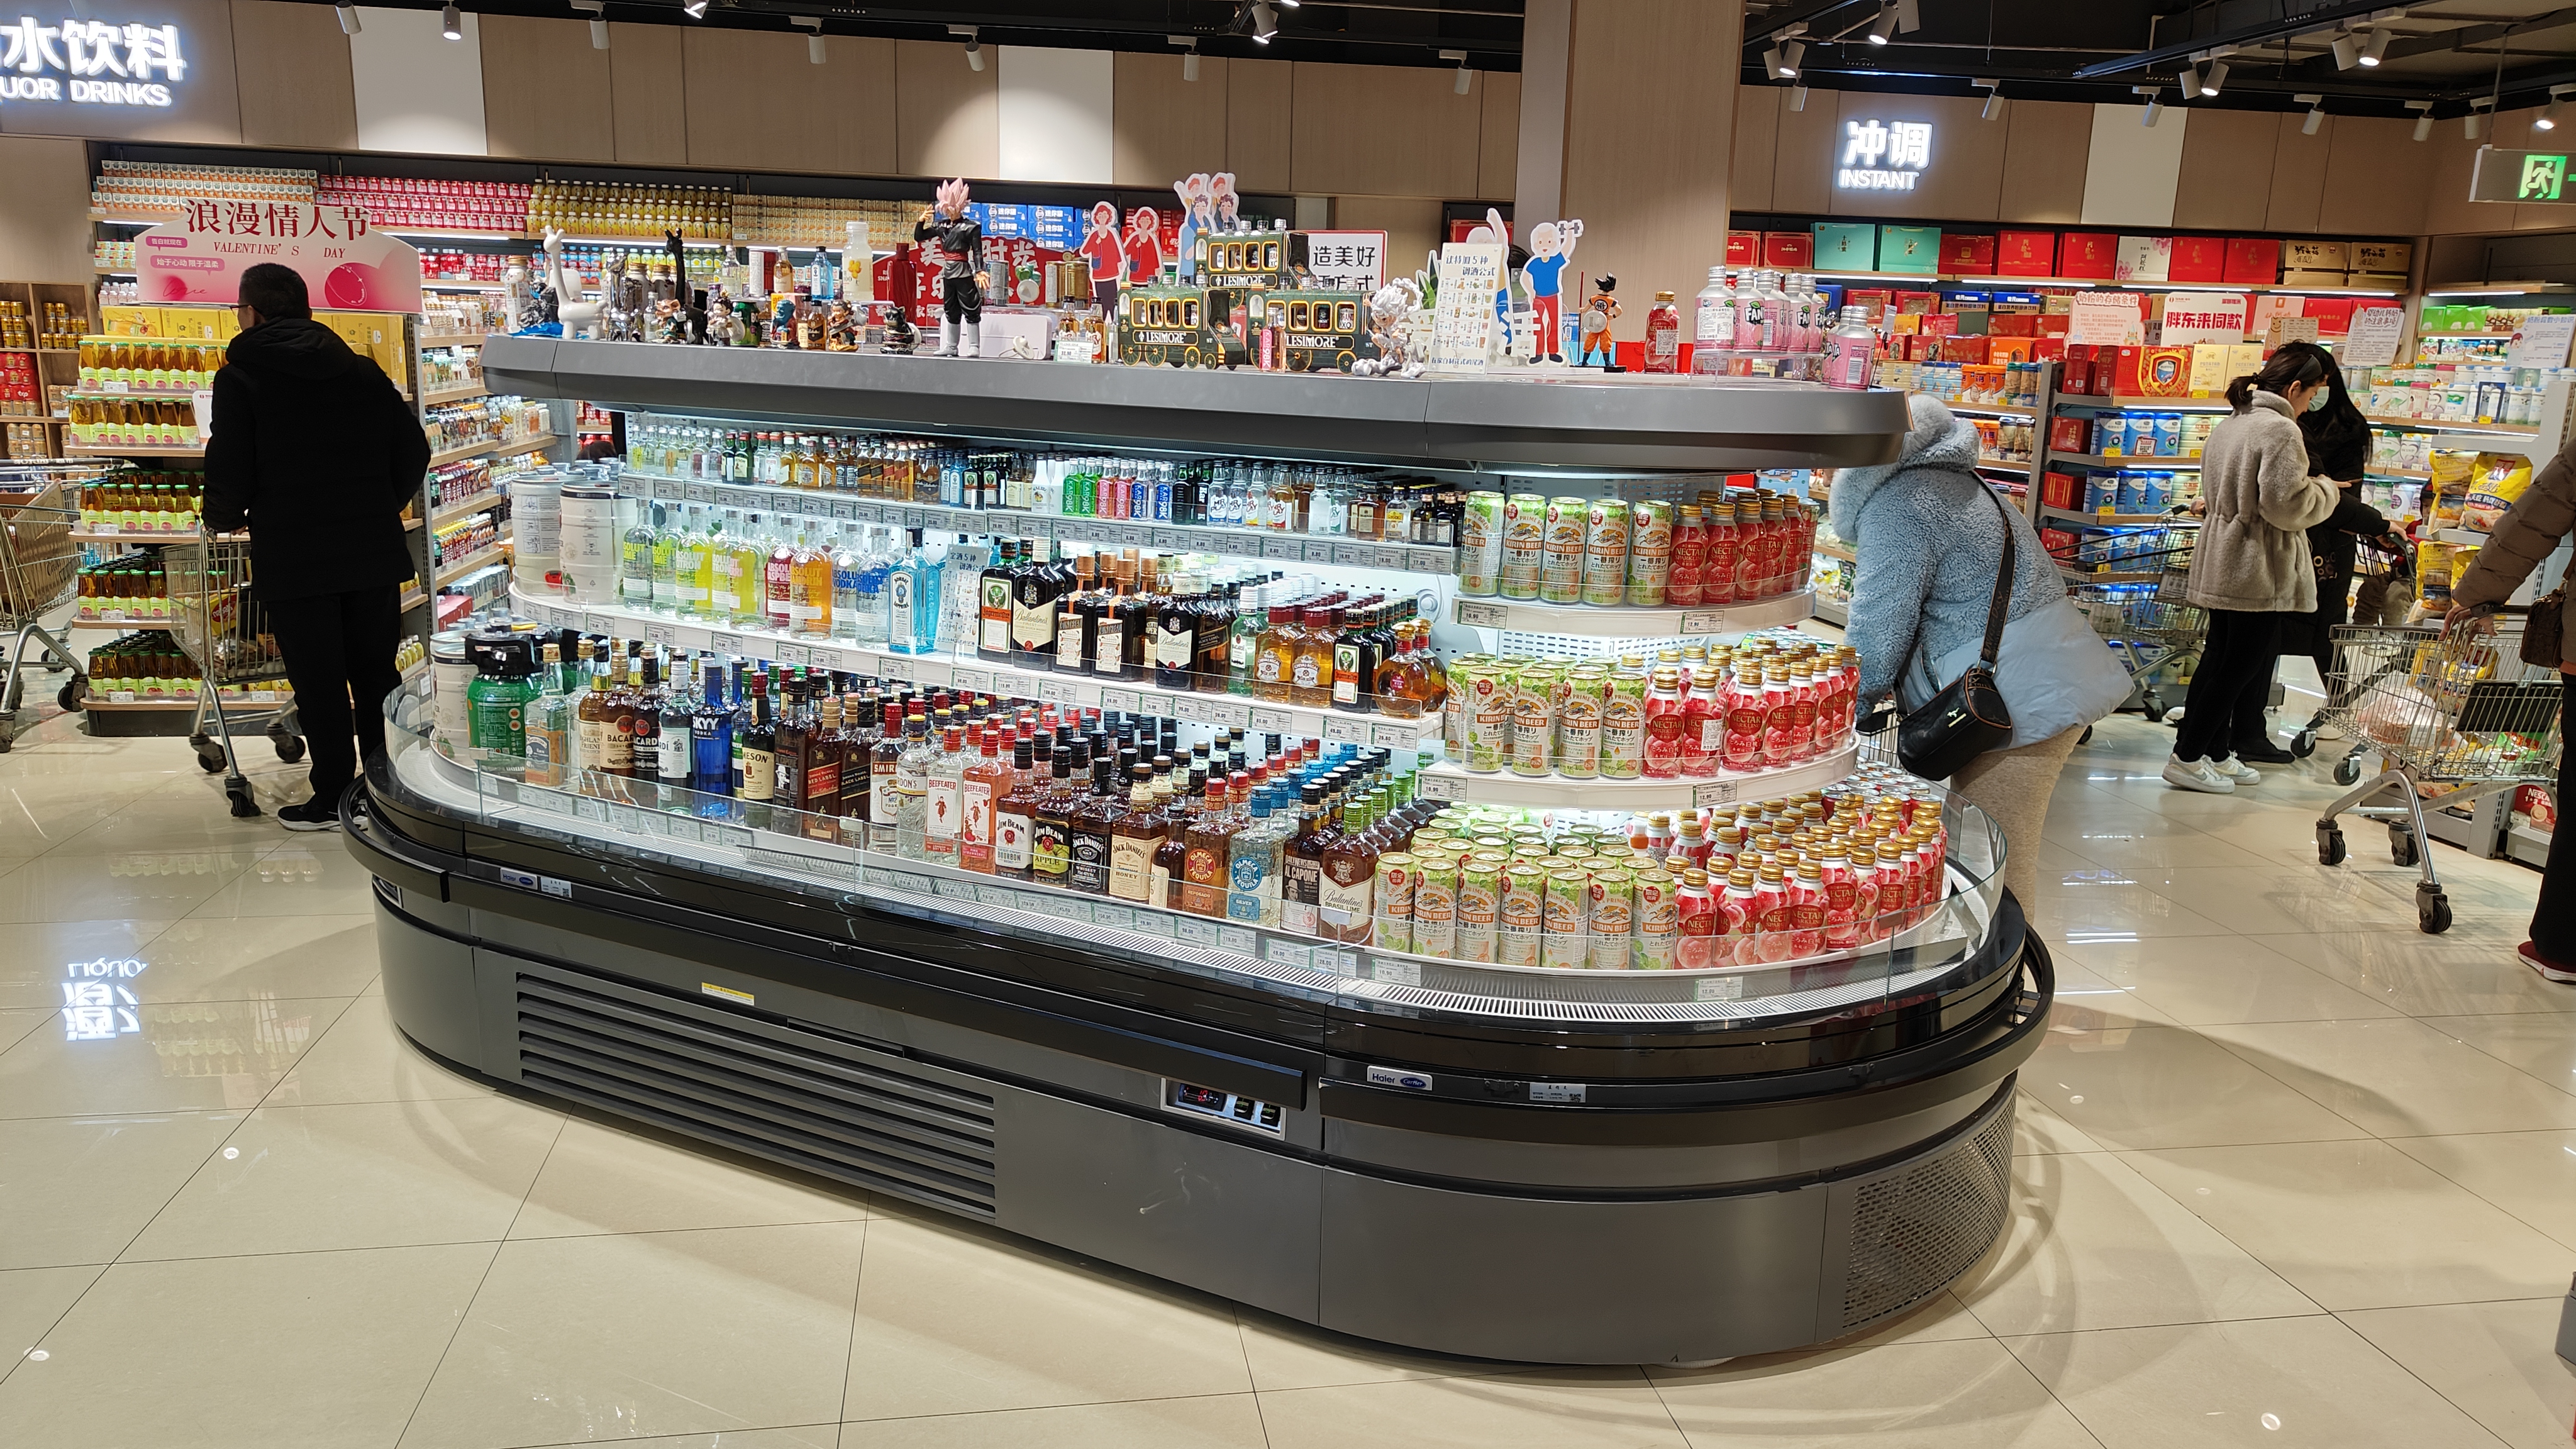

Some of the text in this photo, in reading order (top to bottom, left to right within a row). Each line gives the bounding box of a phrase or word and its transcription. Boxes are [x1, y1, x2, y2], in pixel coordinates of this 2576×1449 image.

[0, 16, 187, 80] 水饮料
[69, 79, 172, 106] DRINKS
[1842, 118, 1934, 169] 冲调
[1838, 168, 1920, 191] INSTANT
[997, 208, 1017, 216] 迷你罐
[1045, 209, 1064, 218] 迷你罐
[186, 199, 370, 241] 浪漫情人节
[1045, 225, 1063, 233] 迷你罐
[152, 238, 182, 246] 告白就现在
[1044, 240, 1063, 248] 迷你罐
[324, 247, 346, 259] DAY
[921, 236, 1038, 267] 美时光
[1308, 245, 1376, 269] 造美好
[157, 258, 219, 269] 始于心动 限于温柔
[1462, 267, 1496, 276] 调酒公式
[1223, 275, 1262, 287] LESIMORE
[2077, 293, 2138, 306] 奶粉的存储条件
[1745, 306, 1763, 321] FAN
[2166, 312, 2243, 330] 胖东来同款
[1146, 332, 1185, 344] LESIMORE
[1286, 335, 1336, 348] LESIMORE
[1469, 538, 1485, 547] BEER
[1506, 539, 1542, 550] KIRIN BEER
[1546, 543, 1584, 553] KIRIN BEER
[1510, 550, 1536, 558] 一番搾り
[1589, 546, 1626, 555] KIRIN BEER
[1674, 547, 1705, 557] NECTAR
[1711, 547, 1738, 556] NECTAR
[692, 716, 719, 730] SKYY
[1579, 720, 1598, 728] BEER
[1652, 719, 1683, 730] NECTAR
[1730, 714, 1761, 724] NECTAR
[1514, 726, 1536, 735] 一番搾り
[607, 735, 633, 743] BACAR
[874, 763, 897, 774] SMIR
[819, 774, 837, 782] LABEL
[855, 774, 870, 782] LABEL
[897, 778, 918, 789] RDON'S
[929, 780, 957, 791] BEEFEATER
[964, 784, 991, 796] BEEFEATER
[2528, 787, 2550, 801] NESCA
[997, 819, 1025, 835] JIM BEAM
[1035, 826, 1064, 844] JIM BEAM
[1073, 835, 1105, 851] JACK DANIEL'S
[1113, 841, 1146, 859] JACK DANIEL'S
[997, 852, 1021, 862] BOURBON
[1035, 855, 1060, 866] APPLE
[1189, 850, 1213, 865] OLMECA
[1296, 857, 1307, 867] NEWS
[1235, 857, 1258, 872] OLMECA
[1116, 872, 1138, 880] HONEY
[1190, 869, 1214, 882] TEQUILA
[1284, 865, 1318, 882] AL CAPONE
[1235, 877, 1262, 891] TEQUILA
[1187, 890, 1211, 898] REPOSADO
[1323, 888, 1363, 908] Ballantine's
[1829, 889, 1857, 899] ECTAR
[1325, 901, 1346, 911] BRASIL
[1391, 905, 1413, 914] KIRIN
[1415, 908, 1451, 919] KIRIN BEER
[1472, 914, 1492, 923] BEER
[1766, 913, 1786, 923] NECT
[1518, 916, 1539, 925] BEER
[1372, 1073, 1396, 1084] Haier
